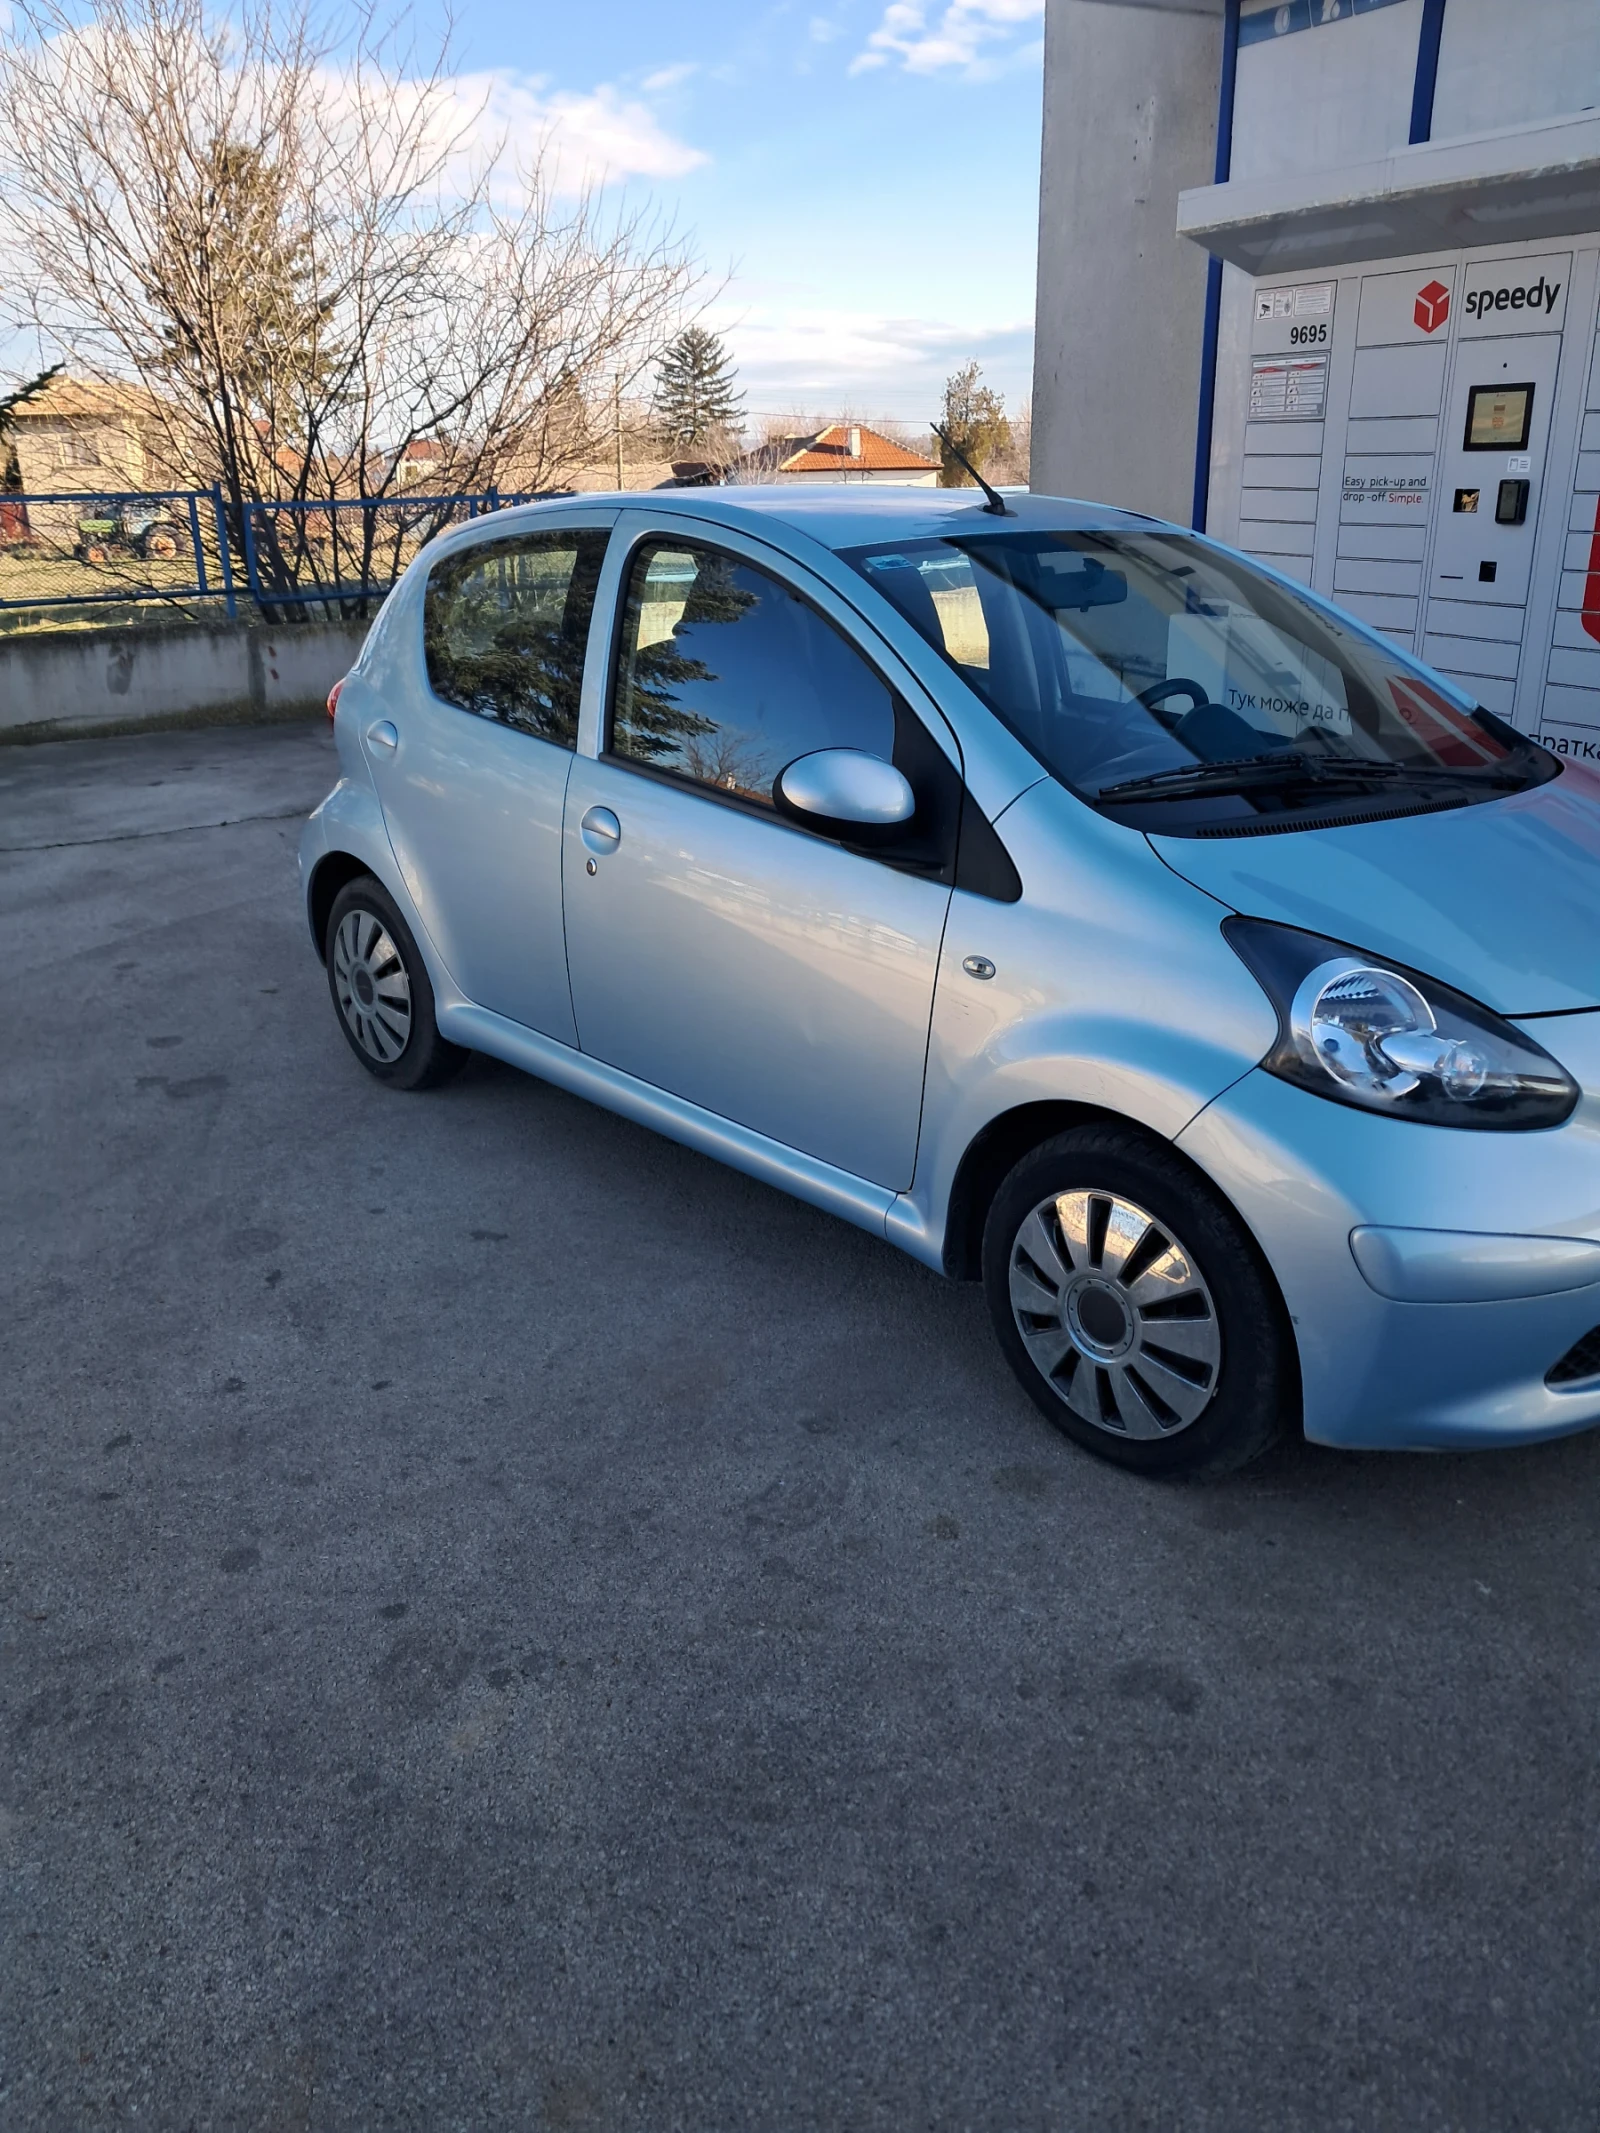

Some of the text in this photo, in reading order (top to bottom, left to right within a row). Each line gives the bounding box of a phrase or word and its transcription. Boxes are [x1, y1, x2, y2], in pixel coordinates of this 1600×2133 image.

[1465, 275, 1561, 320] speedy
[1290, 324, 1327, 344] 9695
[1345, 476, 1427, 489] Easy pick-up and
[1343, 491, 1364, 503] drop
[1228, 688, 1256, 711] Тук
[1260, 696, 1309, 717] може
[1312, 704, 1334, 721] да
